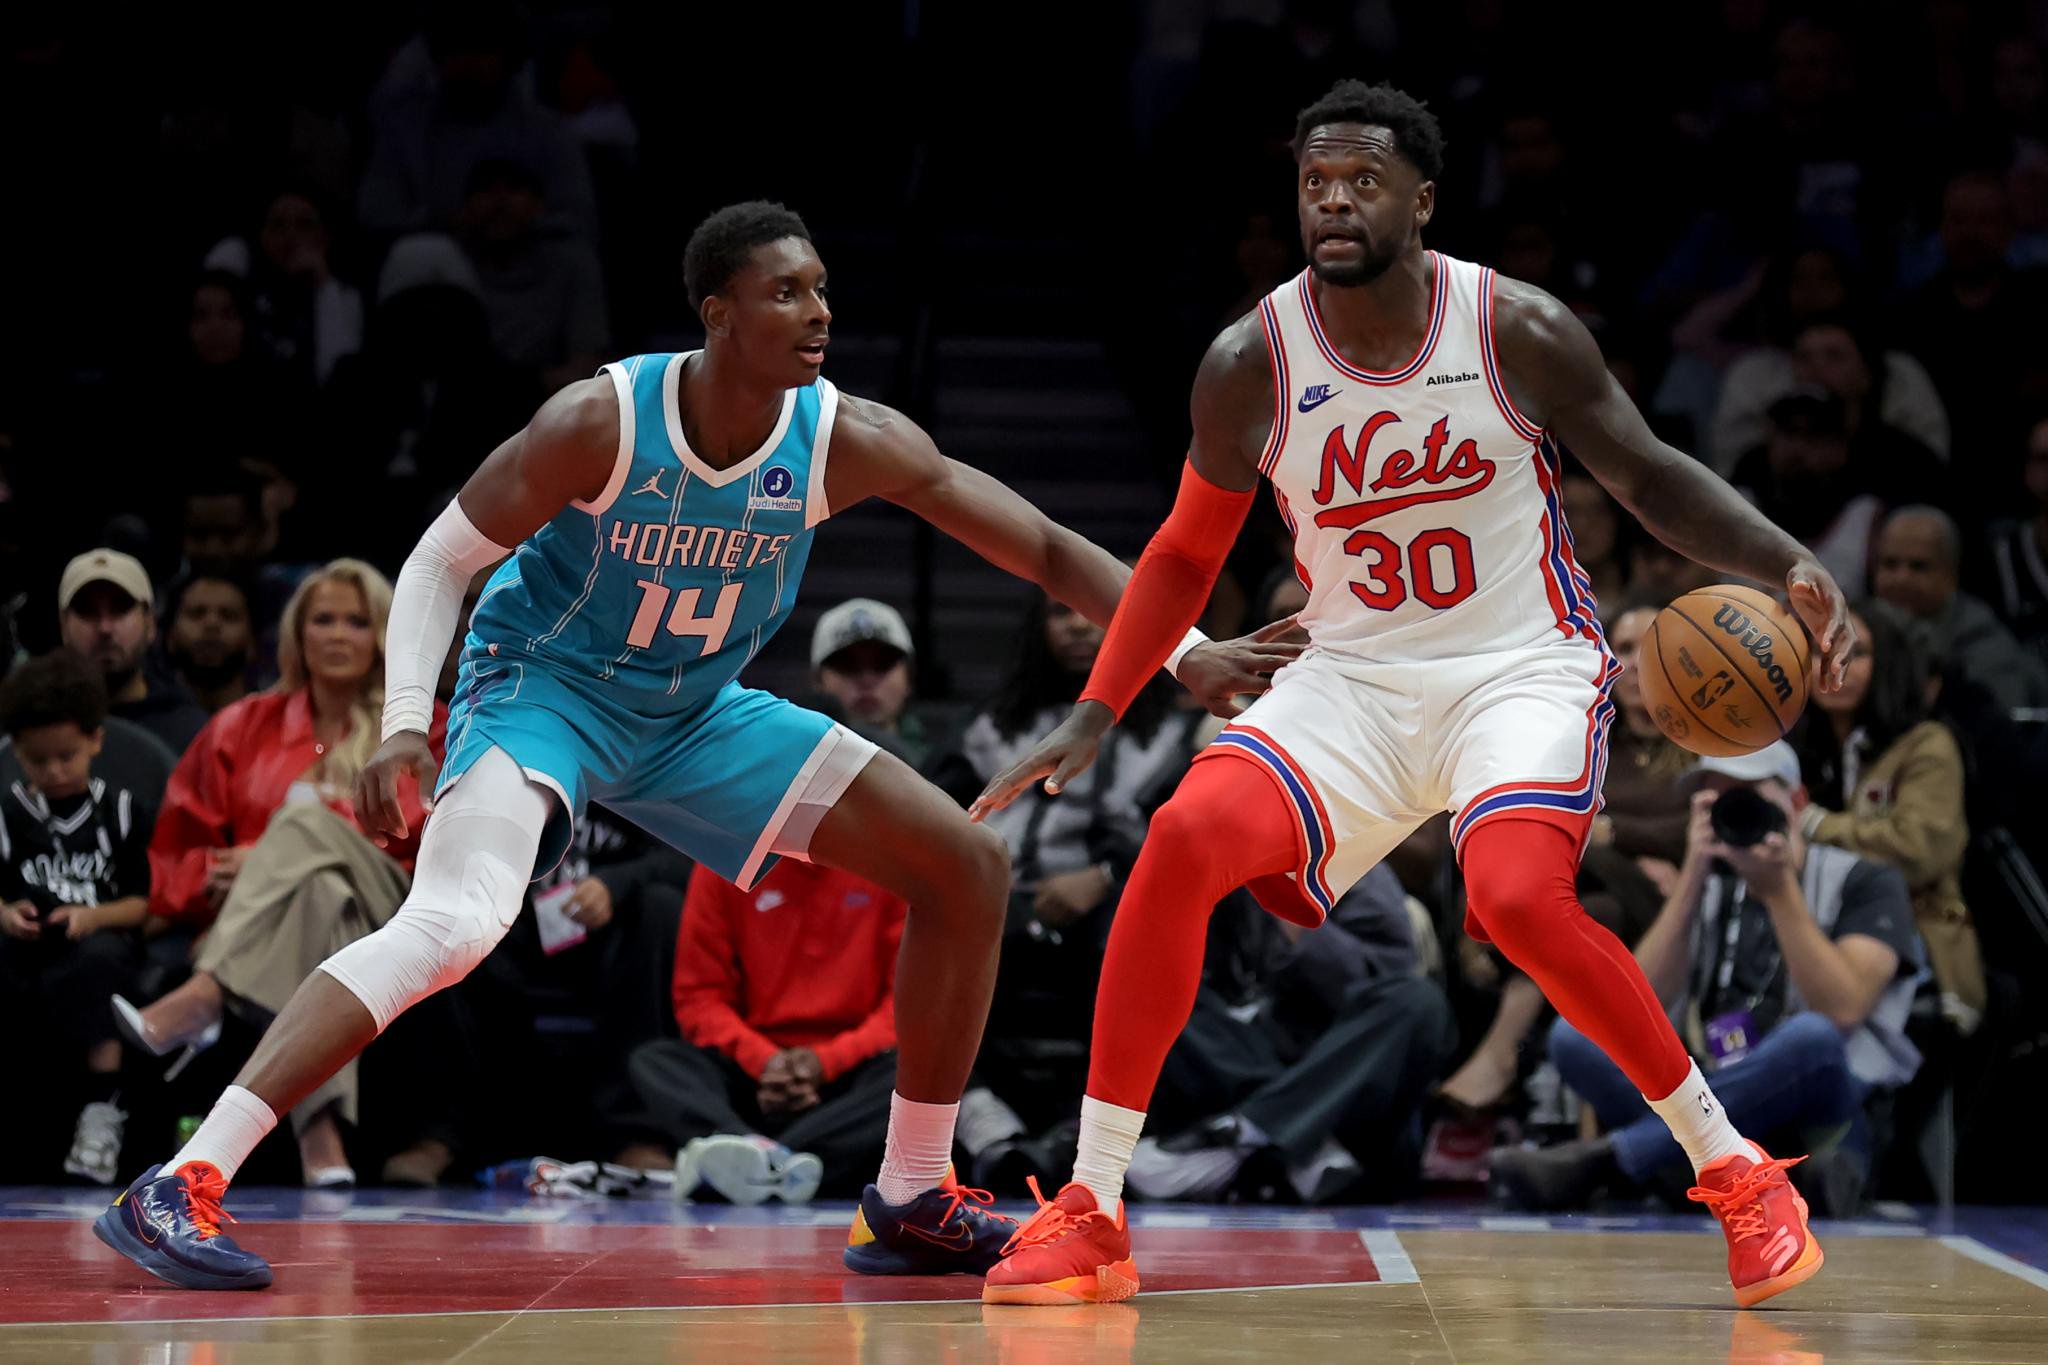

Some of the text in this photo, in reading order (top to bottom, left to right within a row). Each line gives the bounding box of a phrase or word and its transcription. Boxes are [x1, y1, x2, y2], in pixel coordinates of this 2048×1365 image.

[1303, 384, 1331, 401] NIKE
[1425, 371, 1480, 386] Alibaba
[1312, 410, 1496, 506] Nets
[749, 499, 801, 510] Judi Health
[608, 520, 793, 569] HORNETS
[1343, 527, 1478, 612] 30
[625, 579, 744, 656] 14
[1713, 603, 1793, 706] Wilson
